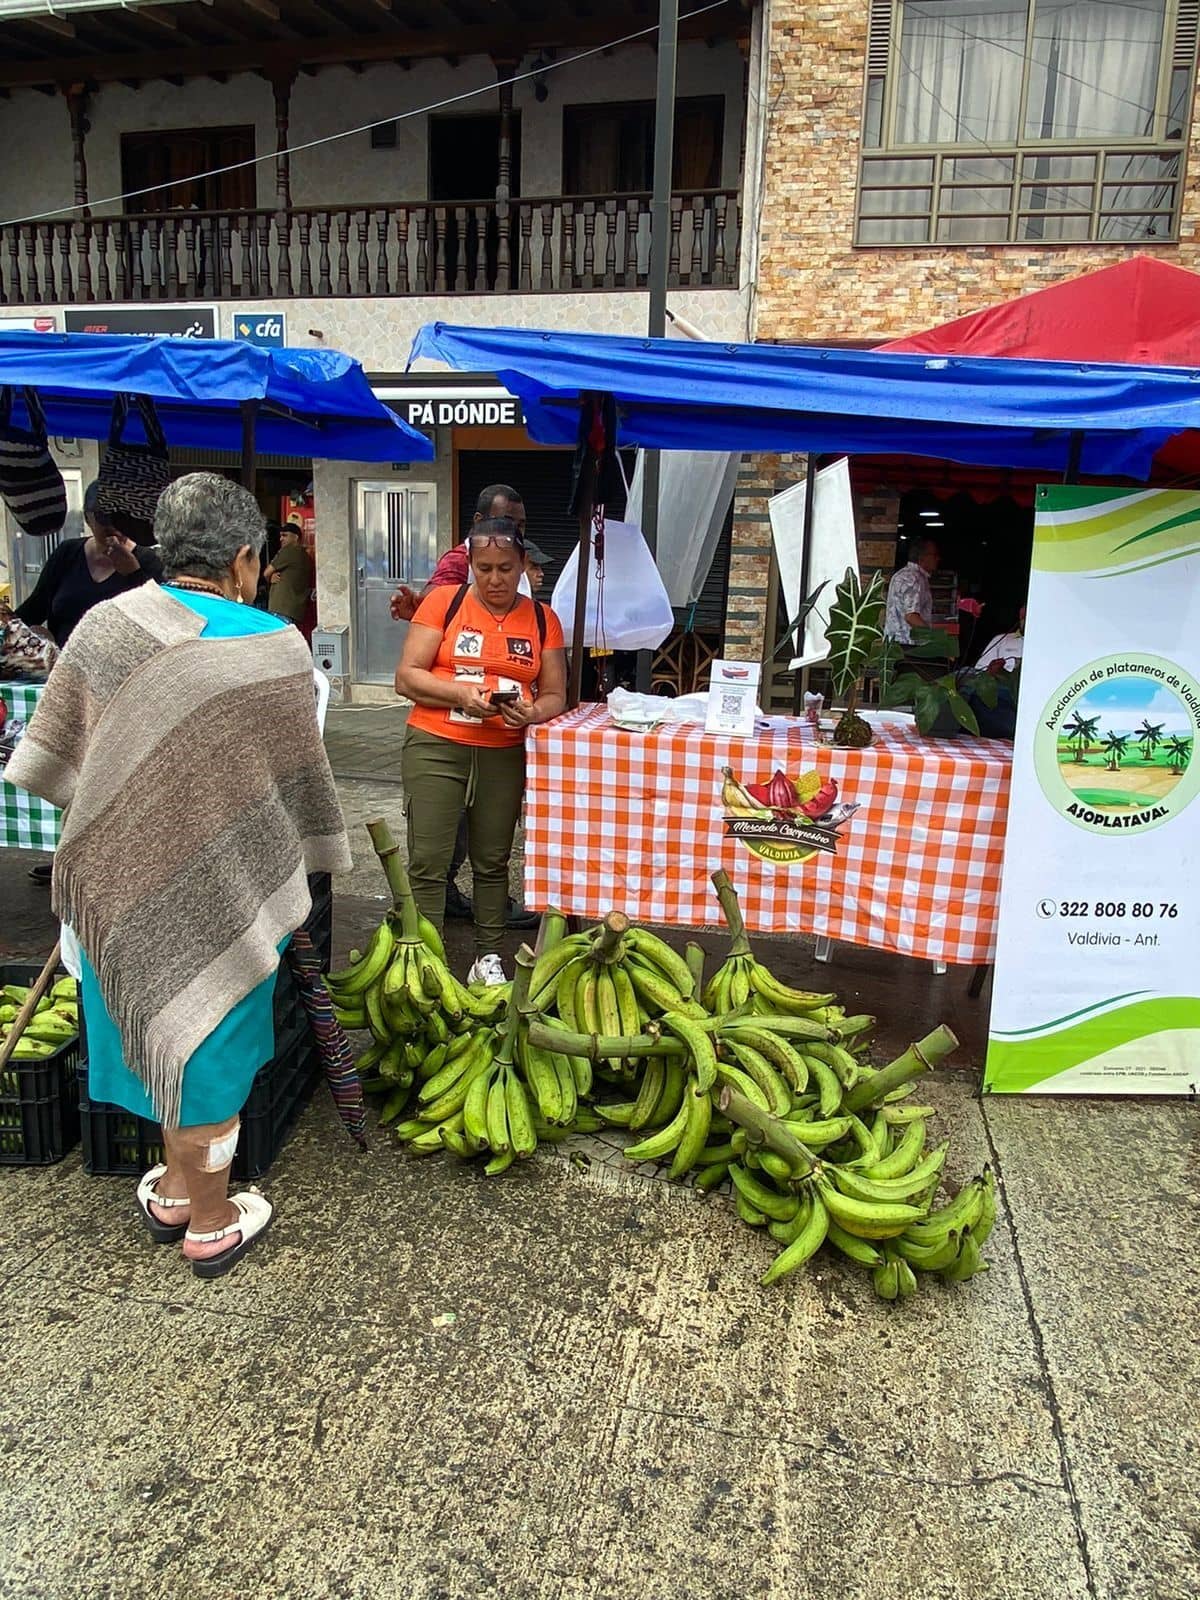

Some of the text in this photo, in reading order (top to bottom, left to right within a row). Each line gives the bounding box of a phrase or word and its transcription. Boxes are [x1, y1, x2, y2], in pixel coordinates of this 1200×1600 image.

[255, 318, 281, 338] cfa
[408, 400, 435, 424] PÁ
[438, 400, 515, 424] DÓNDE
[1045, 679, 1088, 730] Asociación
[1089, 670, 1104, 682] de
[1106, 662, 1166, 678] plataneros
[1166, 675, 1180, 688] de
[1066, 802, 1169, 828] ASOPLATAVAL
[733, 821, 778, 833] Mercado
[759, 844, 800, 860] VALDIVIA
[1059, 901, 1179, 918] 322 808 80 76
[1067, 931, 1121, 946] Valdivia
[1133, 933, 1161, 946] Ant.
